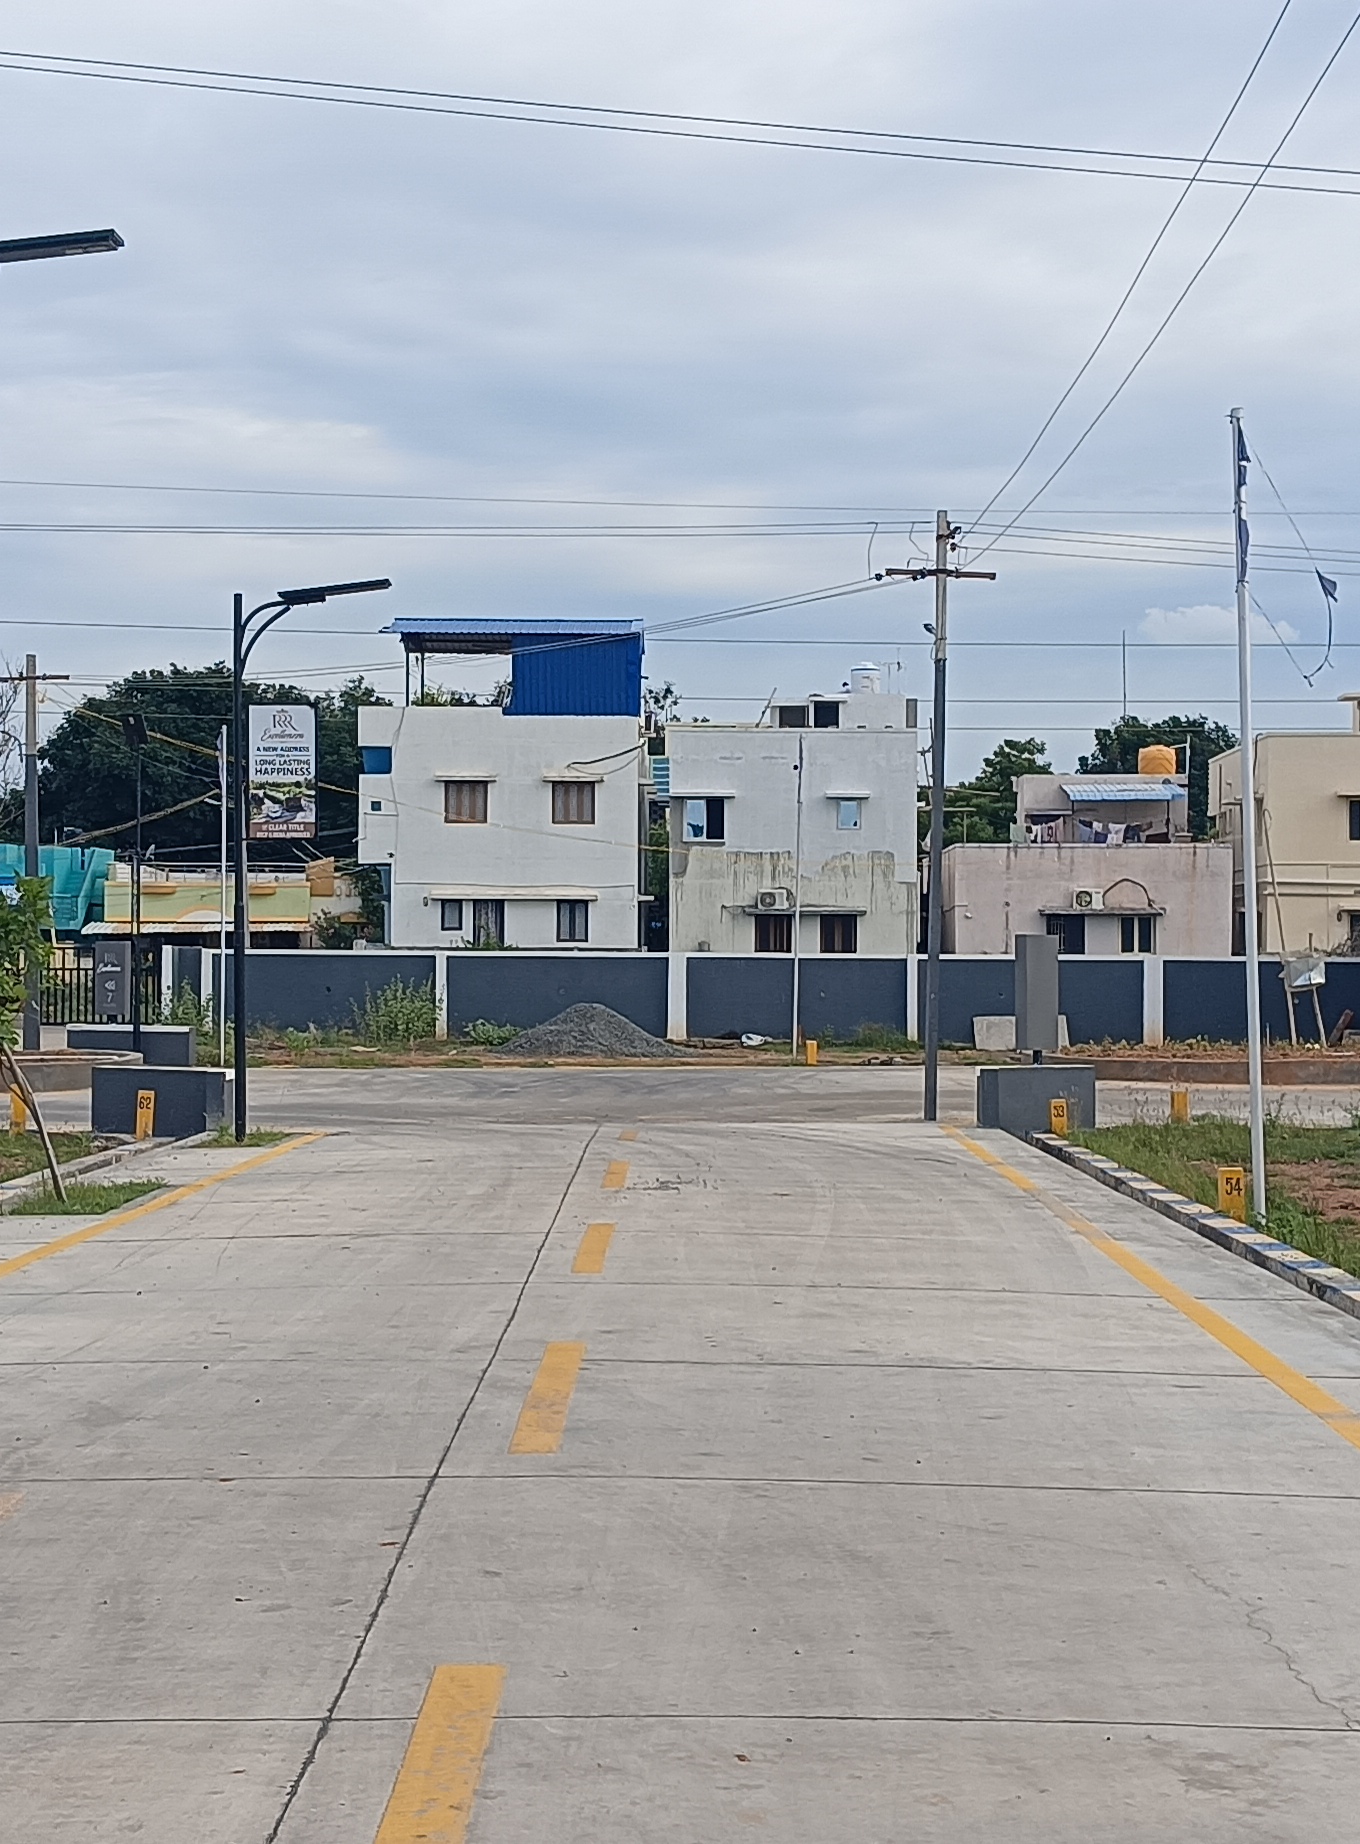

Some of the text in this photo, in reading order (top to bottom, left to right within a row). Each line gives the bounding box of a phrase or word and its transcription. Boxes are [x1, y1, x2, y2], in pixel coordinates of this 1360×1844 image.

[255, 767, 311, 776] HAPPINESS
[139, 1096, 151, 1110] 62
[1053, 1105, 1065, 1118] 53
[1225, 1177, 1243, 1197] 54
